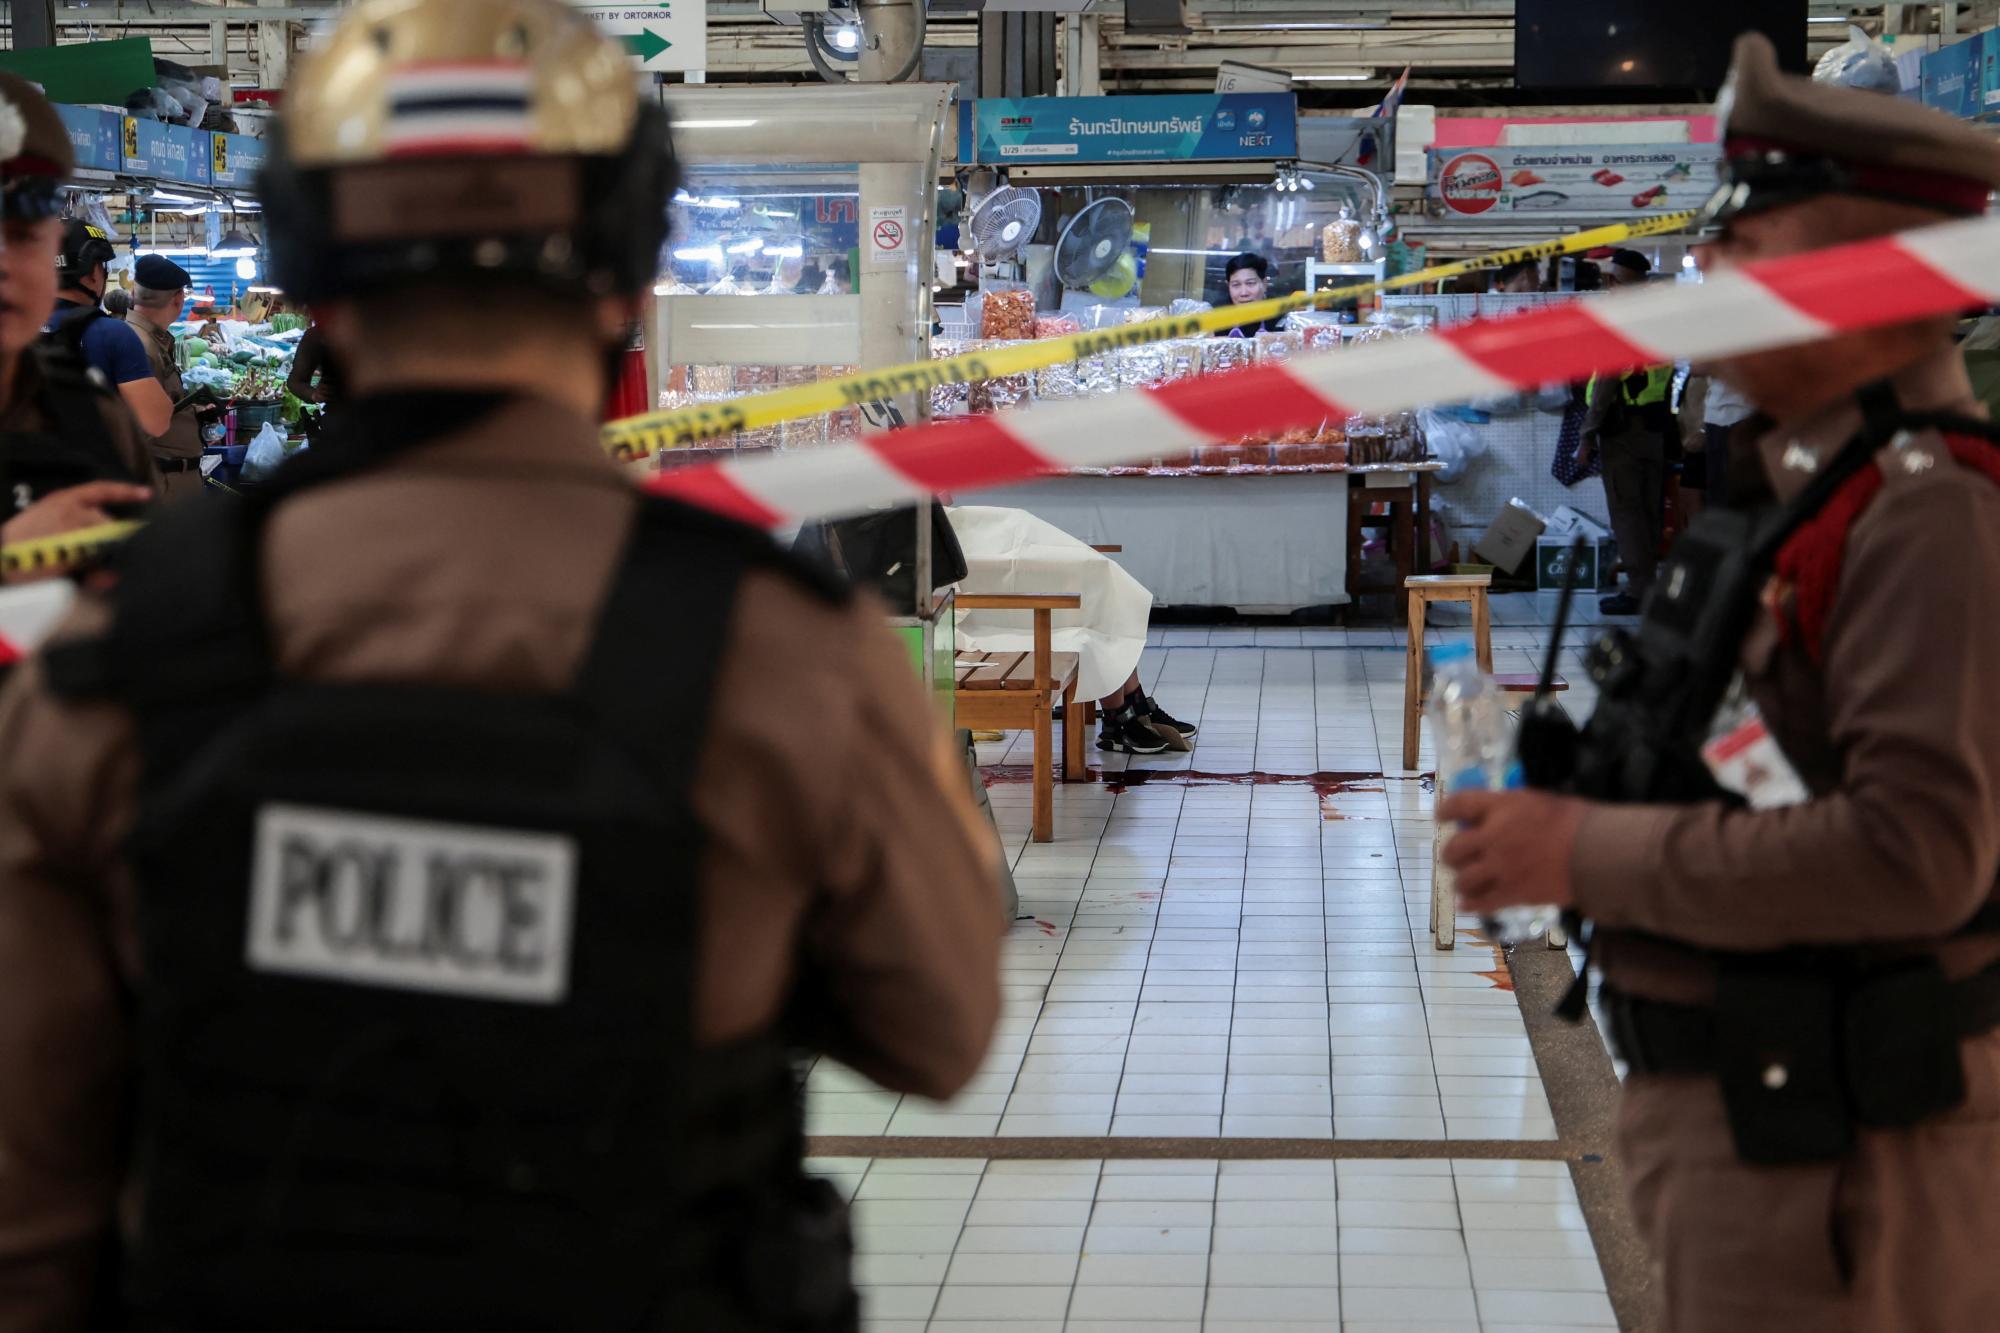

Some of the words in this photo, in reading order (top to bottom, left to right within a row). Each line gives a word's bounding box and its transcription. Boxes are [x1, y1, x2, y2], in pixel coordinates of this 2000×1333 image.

[609, 12, 619, 20] BY
[624, 11, 671, 20] ORTORKOR
[1240, 136, 1272, 146] NEXT
[274, 834, 546, 976] POLICE
